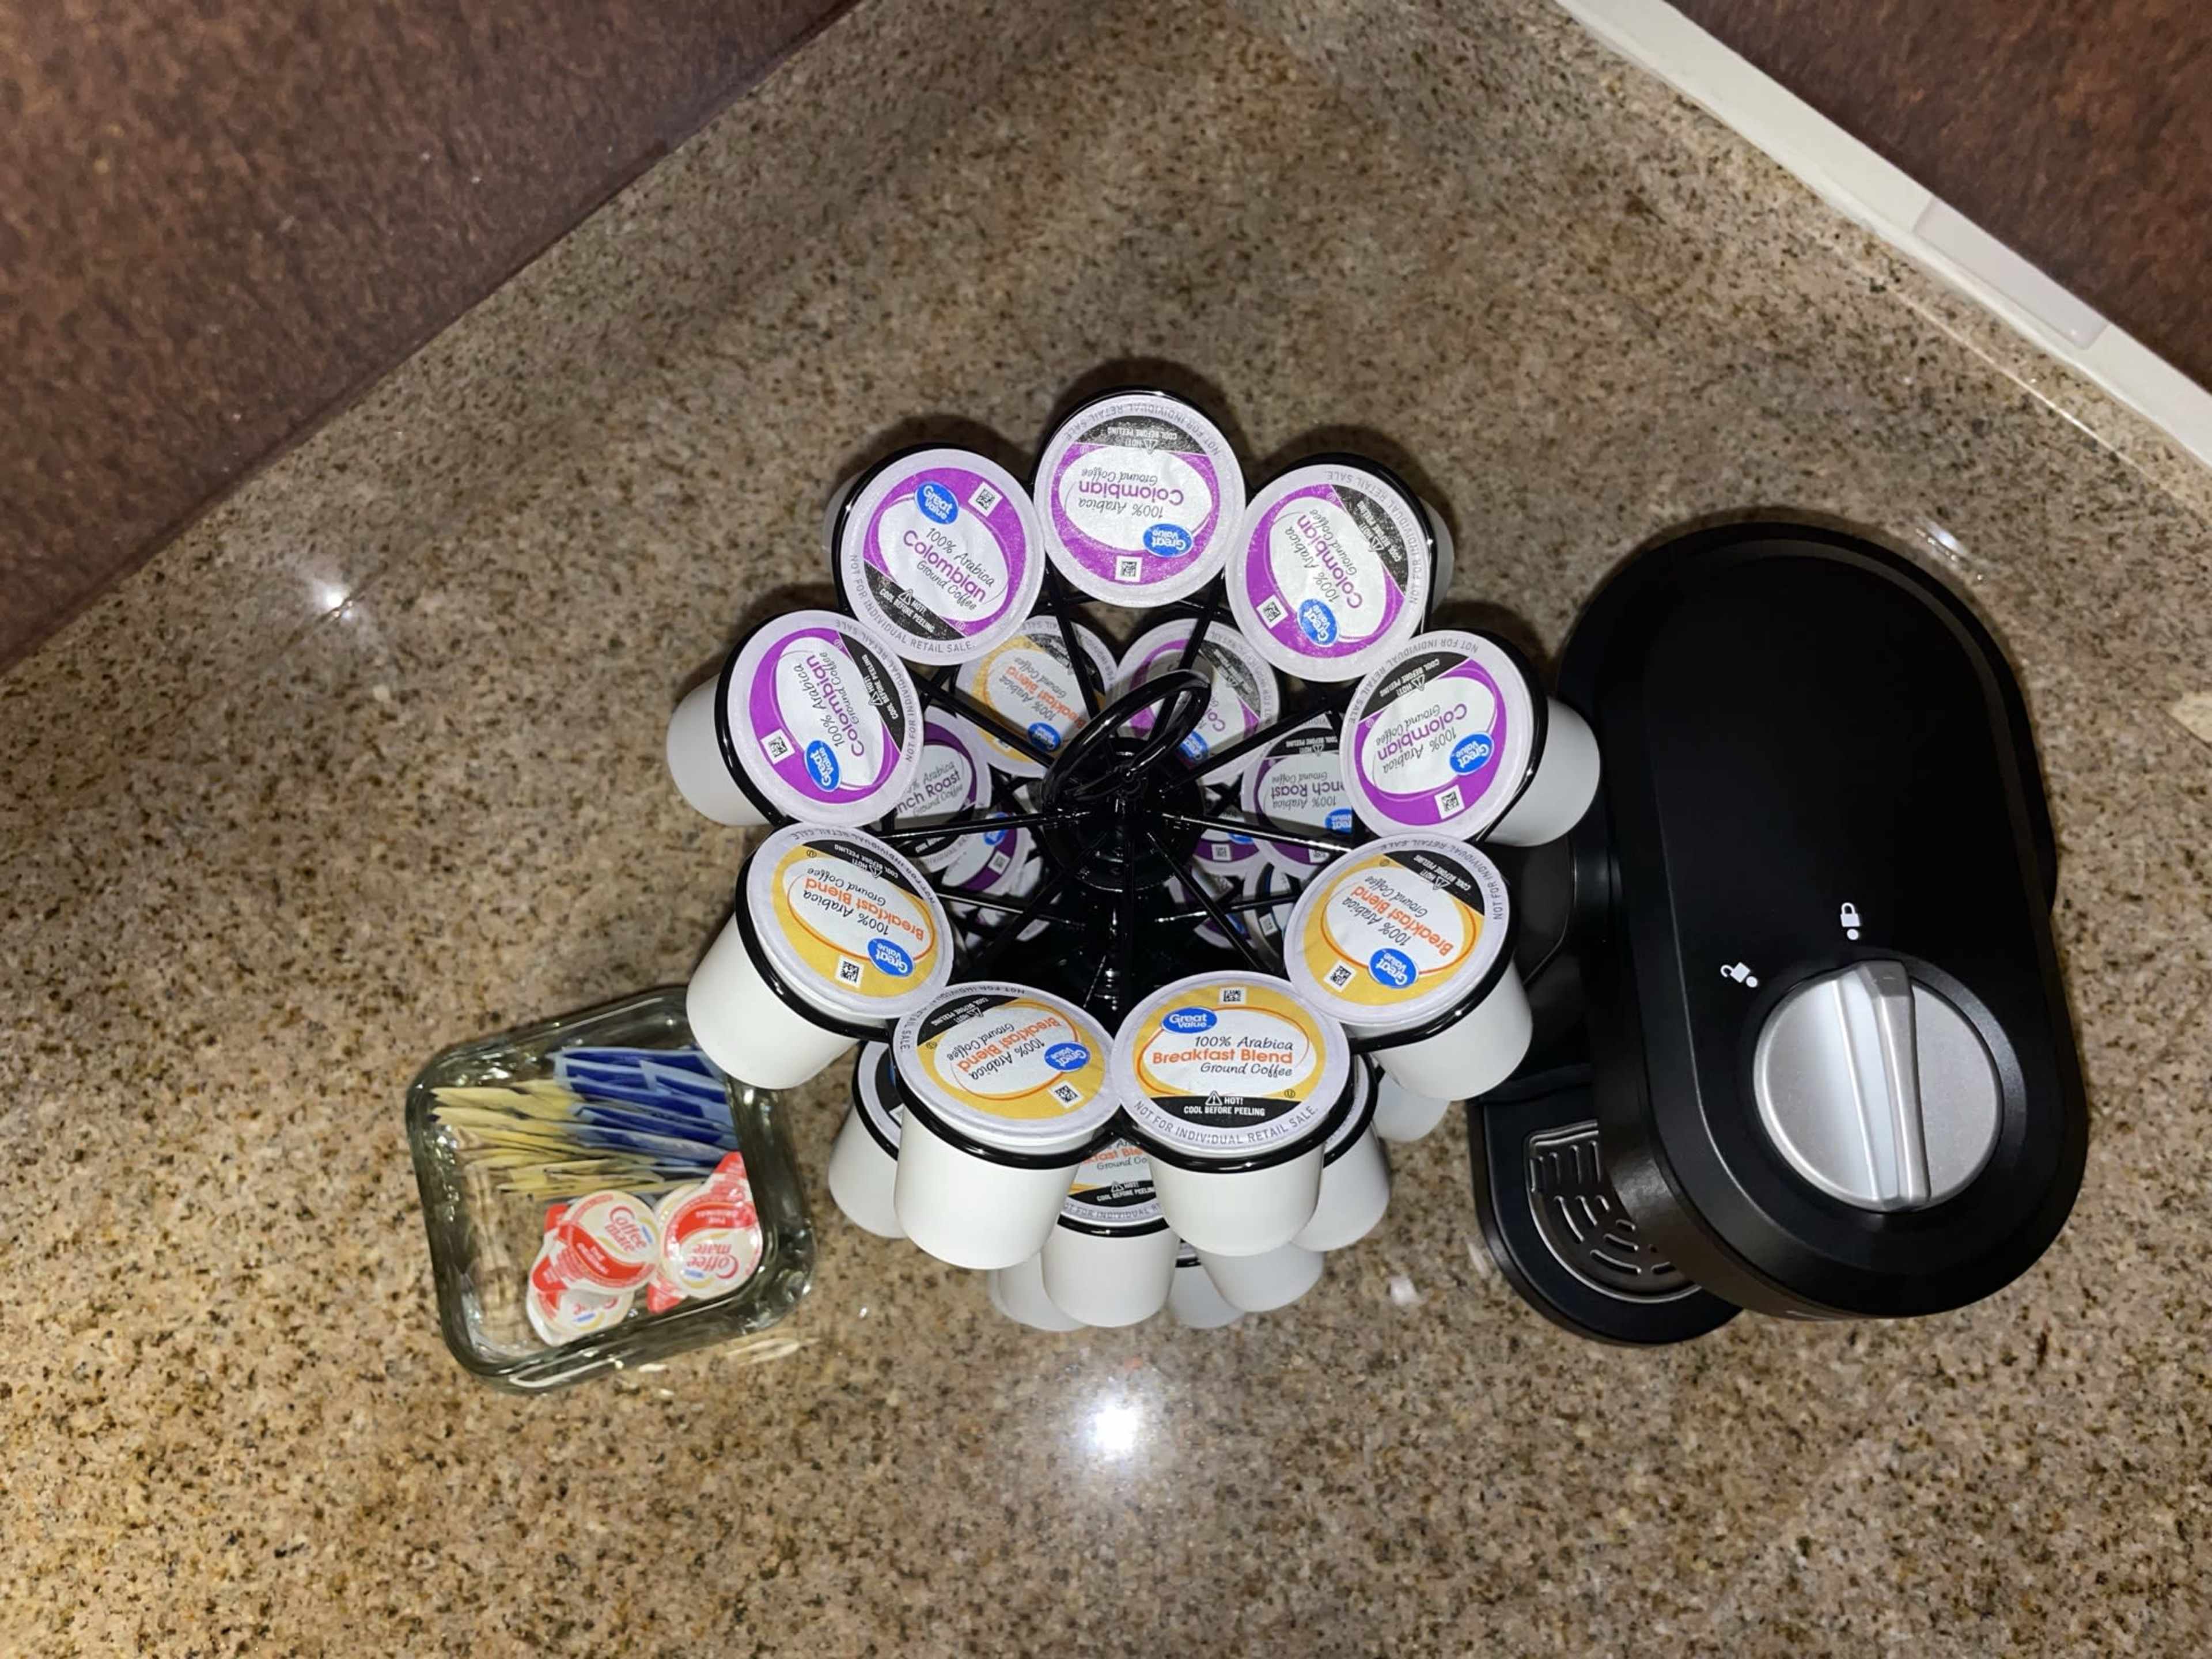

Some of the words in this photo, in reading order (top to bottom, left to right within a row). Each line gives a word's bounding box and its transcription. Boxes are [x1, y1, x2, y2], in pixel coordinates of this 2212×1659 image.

[1082, 467, 1116, 482] Coffee
[1120, 475, 1158, 484] Ground
[923, 484, 953, 514] Great
[1079, 481, 1184, 505] Colombian
[924, 499, 948, 520] Value
[1078, 498, 1126, 514] Arabica
[1132, 503, 1163, 518] 100%
[1309, 509, 1334, 541] Coffee
[1151, 537, 1185, 550] Great
[1285, 527, 1319, 569] Arabica
[850, 554, 859, 575] NOT
[904, 530, 986, 602] Colombian
[926, 528, 957, 554] 100%
[955, 552, 994, 586] Arabica
[1297, 514, 1363, 608] Colombian
[1330, 540, 1358, 575] Ground
[1413, 559, 1422, 579] FOR
[854, 578, 866, 599] FOR
[917, 560, 948, 589] Ground
[948, 585, 976, 610] Coffee
[1313, 571, 1340, 604] 100%
[1410, 582, 1421, 604] NOT
[865, 600, 906, 644] INDIVIDUAL
[880, 588, 893, 605] COOL
[892, 599, 915, 620] BEFORE
[913, 614, 935, 633] PEELING
[1304, 608, 1327, 641] Great
[911, 639, 943, 653] RETAIL
[1386, 639, 1437, 666] INDIVIDUAL
[1441, 639, 1458, 647] FOR
[1461, 641, 1478, 653] NOT
[820, 652, 842, 685] Coffee
[862, 654, 878, 679] PEELING
[793, 664, 825, 709] Arabica
[874, 680, 889, 703] BEFORE
[806, 654, 865, 756] Colombian
[838, 686, 859, 725] Ground
[887, 703, 899, 719] COOL
[1406, 704, 1440, 728] Ground
[821, 714, 845, 747] 100%
[1376, 724, 1403, 745] Coffee
[1377, 703, 1467, 760] Colombian
[1430, 727, 1456, 750] 100%
[906, 740, 916, 762] NOT
[1383, 745, 1423, 774] Arabica
[1458, 744, 1488, 768] Great
[810, 749, 830, 787] Great
[925, 770, 960, 798] Roast
[1271, 783, 1308, 798] Roast
[835, 844, 859, 858] PEELING
[807, 868, 844, 888] Coffee
[885, 868, 898, 878] COOL
[1455, 878, 1471, 891] COOL
[805, 878, 853, 905] Blend
[848, 883, 885, 906] Ground
[1364, 876, 1393, 898] Coffee
[1487, 881, 1502, 899] FOR
[802, 890, 853, 918] Arabica
[1342, 896, 1382, 925] Arabica
[1350, 886, 1389, 913] Blend
[1393, 892, 1427, 918] Ground
[1493, 902, 1503, 920] NOT
[856, 899, 924, 941] Breakfast
[857, 913, 888, 935] 100%
[1378, 922, 1411, 946] 100%
[1388, 908, 1454, 957] Breakfast
[875, 950, 908, 974] Great
[876, 943, 901, 958] Value
[1382, 953, 1407, 971] Value
[1376, 959, 1407, 984] Great
[1169, 1014, 1207, 1024] Great
[981, 1023, 1014, 1047] Ground
[1002, 1017, 1062, 1048] Breakfast
[1195, 1036, 1232, 1047] 100%
[1237, 1036, 1293, 1050] Arabica
[947, 1041, 980, 1061] Coffee
[957, 1045, 1002, 1073] Blend
[1014, 1037, 1045, 1057] 100%
[1056, 1051, 1086, 1067] Great
[1153, 1049, 1234, 1064] Breakfast
[1241, 1049, 1292, 1064] Blend
[971, 1056, 1013, 1080] Arabica
[1200, 1063, 1247, 1075] Ground
[1251, 1063, 1293, 1078] Coffee
[1205, 1106, 1232, 1115] BEFORE
[1234, 1107, 1265, 1116] PEELING
[1225, 1097, 1243, 1105] HOT!
[1134, 1101, 1153, 1116] NOT
[1153, 1117, 1173, 1132] FOR
[1175, 1125, 1243, 1144] INDIVIDUAL
[1248, 1124, 1289, 1142] RETAIL
[1097, 1157, 1132, 1170] Ground
[610, 1206, 647, 1249] Coffee
[687, 1254, 738, 1278] Coffee
